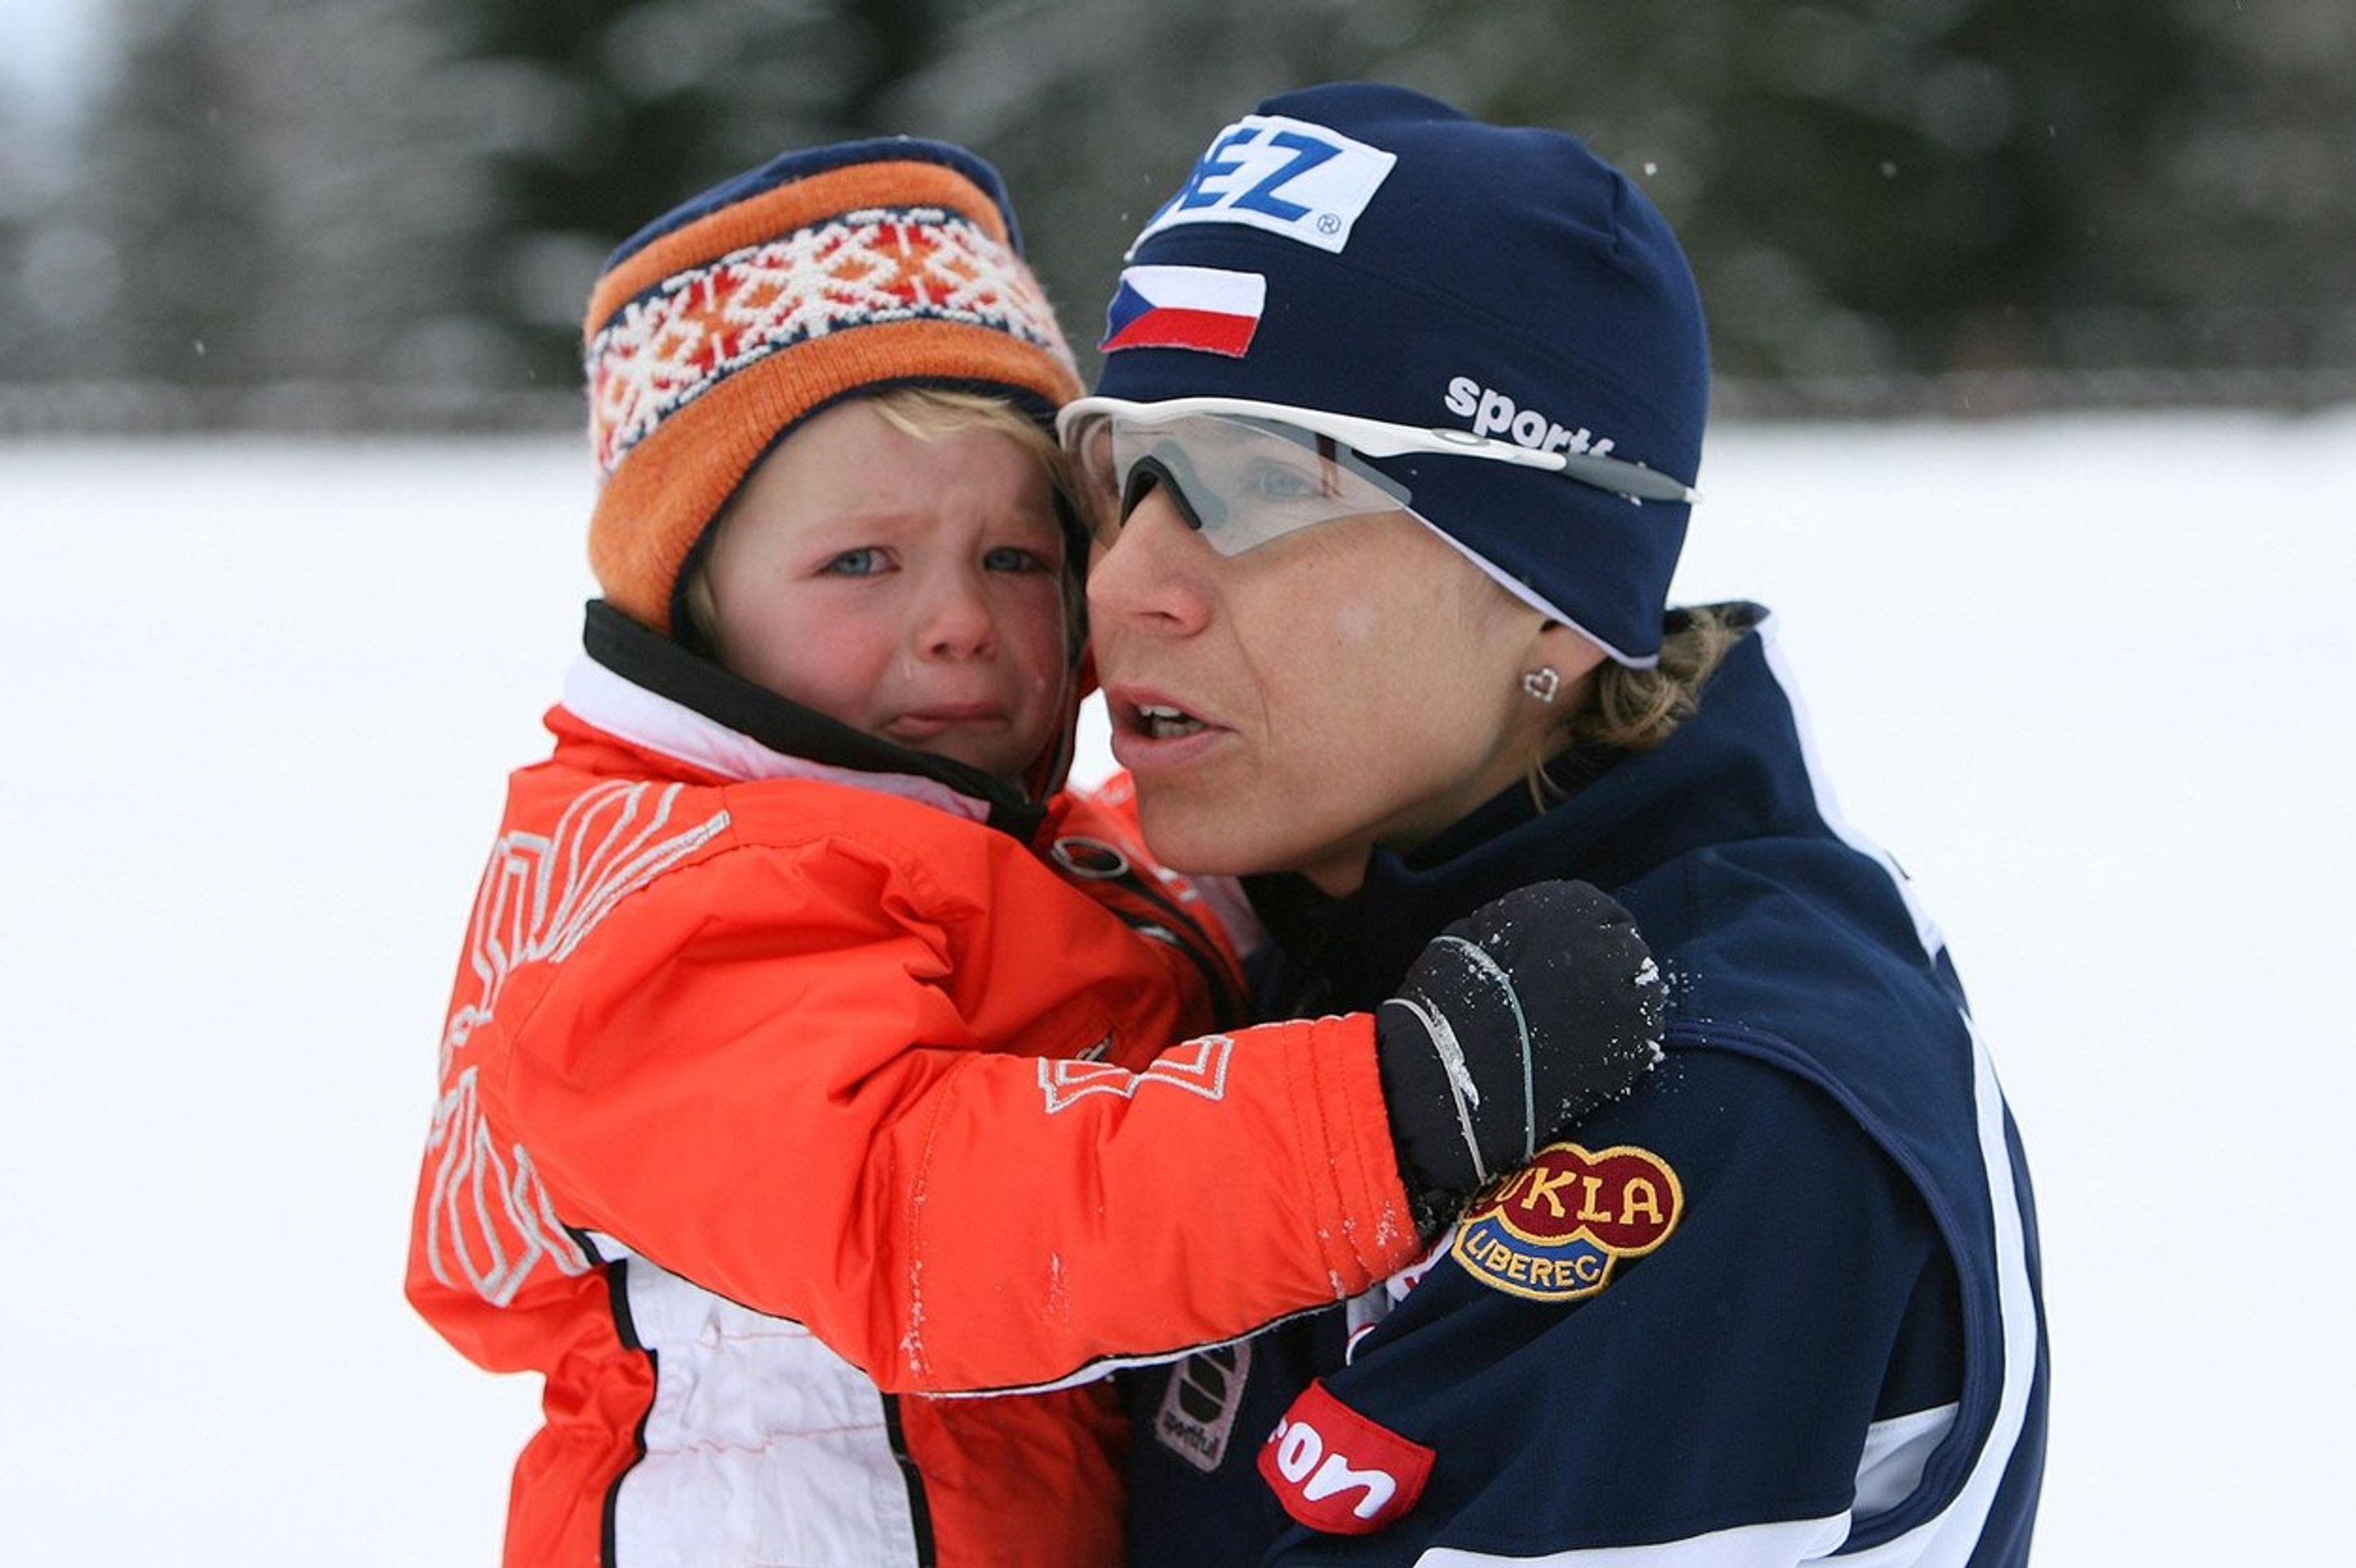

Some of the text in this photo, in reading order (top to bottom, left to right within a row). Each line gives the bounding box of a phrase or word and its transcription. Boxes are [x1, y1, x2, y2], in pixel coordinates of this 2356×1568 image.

[1146, 127, 1344, 223] EZ
[1444, 376, 1616, 457] sport
[1465, 1228, 1601, 1287] LIBEREC
